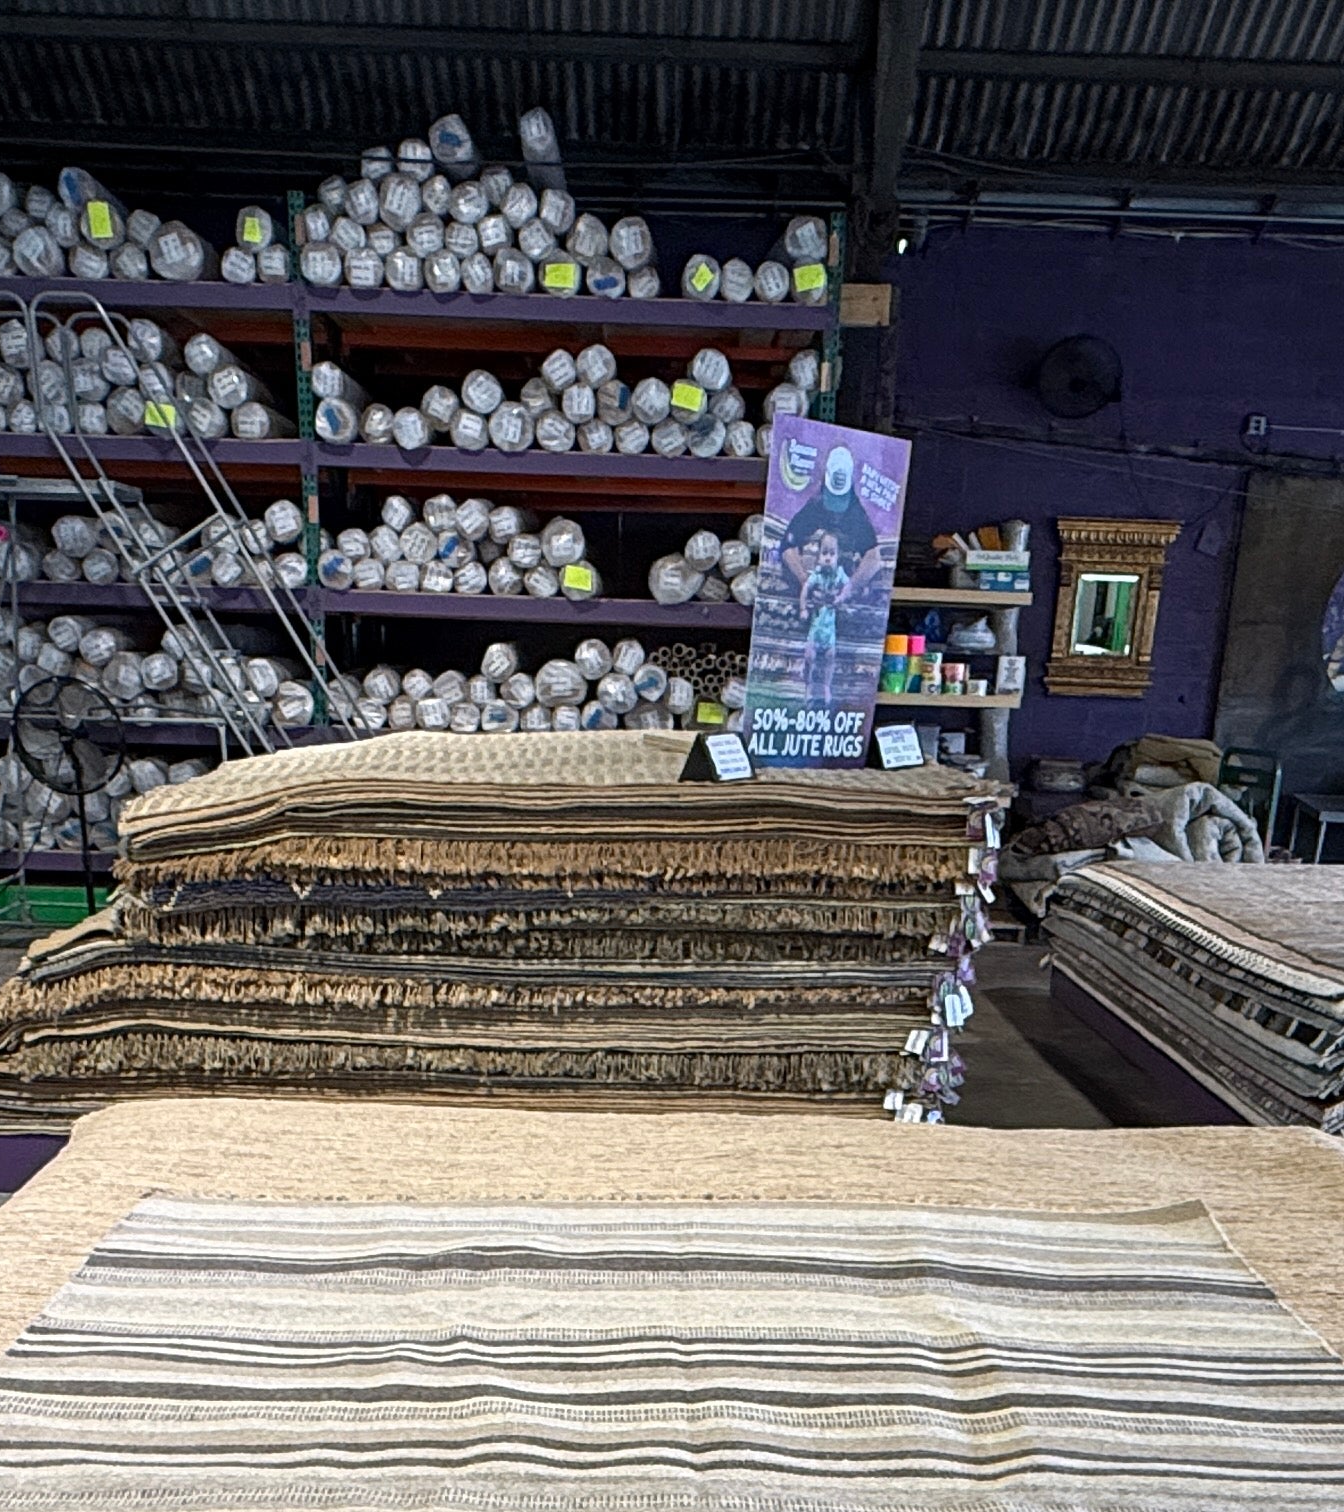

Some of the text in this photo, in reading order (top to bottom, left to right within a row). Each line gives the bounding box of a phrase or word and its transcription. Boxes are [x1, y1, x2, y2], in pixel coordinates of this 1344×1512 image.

[752, 707, 866, 734] 50%-80% OFF
[747, 732, 778, 756] ALL
[781, 733, 822, 757] JUTE
[822, 734, 864, 758] RUGS
